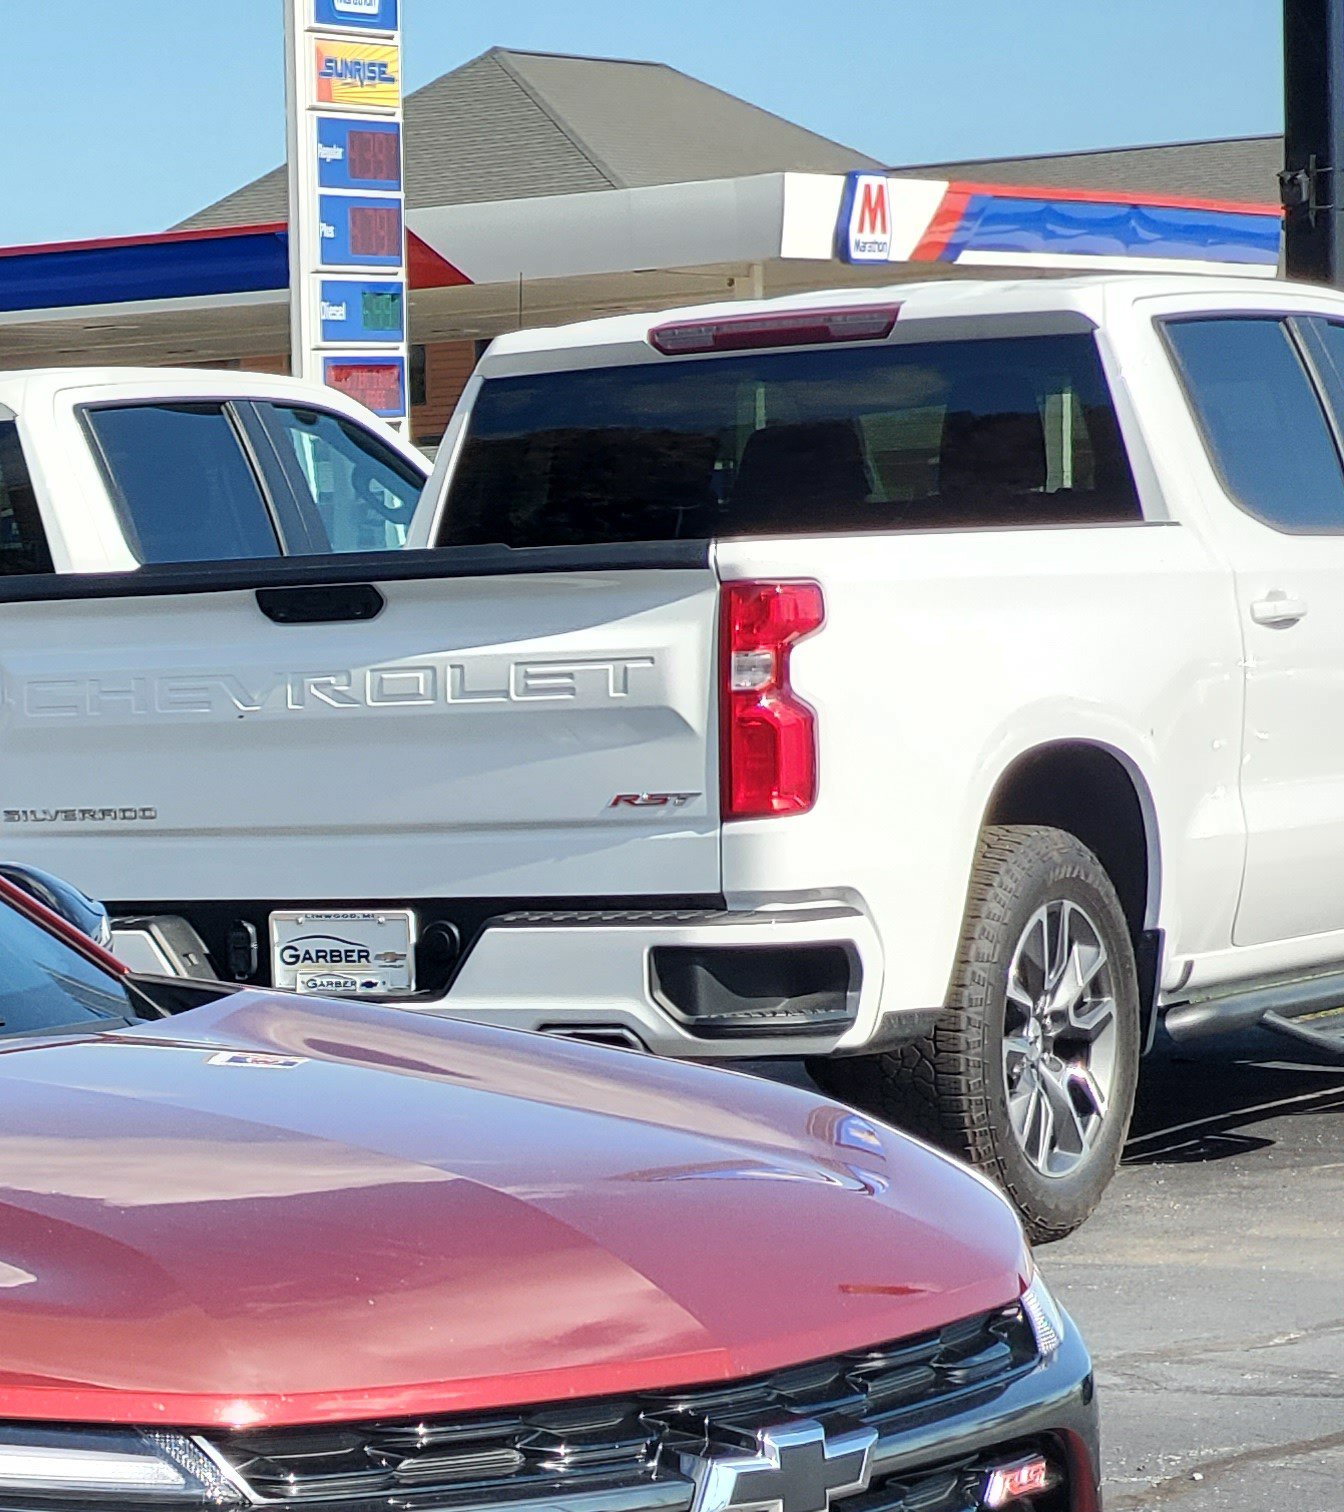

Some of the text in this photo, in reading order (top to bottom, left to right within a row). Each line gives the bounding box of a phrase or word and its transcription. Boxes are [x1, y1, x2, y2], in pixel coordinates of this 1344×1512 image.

[319, 57, 395, 88] SUNRISE
[857, 183, 887, 235] M
[854, 238, 888, 253] Marathon
[320, 301, 346, 320] Diesel
[24, 655, 656, 717] CHEVROLET
[609, 792, 703, 808] RST
[3, 807, 157, 823] SILVERADO
[280, 945, 372, 966] GARBER
[306, 978, 357, 988] GARBER
